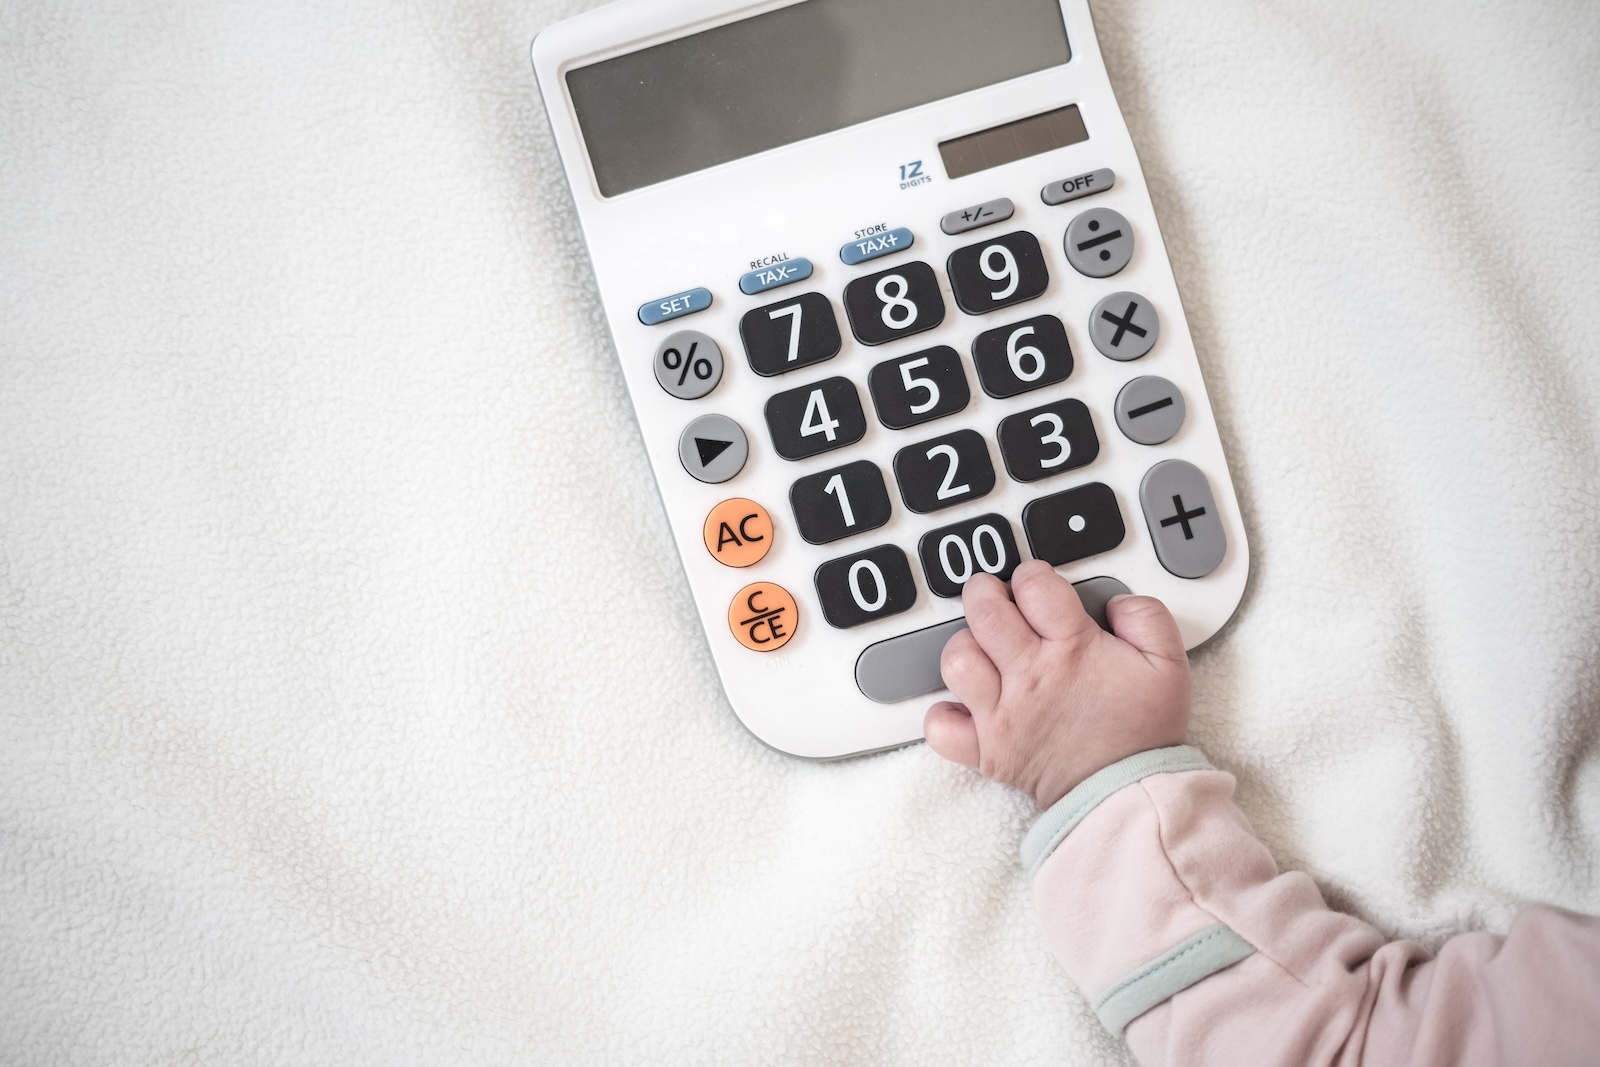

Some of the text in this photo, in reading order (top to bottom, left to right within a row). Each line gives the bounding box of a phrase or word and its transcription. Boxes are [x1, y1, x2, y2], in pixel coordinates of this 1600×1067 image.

[899, 161, 923, 180] 12
[900, 175, 931, 190] DIGITS
[1062, 174, 1094, 193] OFF
[855, 223, 888, 239] STORE
[857, 234, 898, 256] TAX+
[750, 253, 789, 270] RECALL
[979, 245, 1019, 300] 9
[660, 295, 692, 315] SET
[875, 274, 918, 330] 8
[769, 303, 802, 362] 7
[1006, 326, 1046, 381] 6
[662, 342, 713, 386] %
[899, 357, 940, 415] 5
[800, 389, 839, 442] 4
[1030, 412, 1071, 468] 3
[926, 444, 970, 500] 2
[824, 474, 855, 527] 1
[717, 513, 764, 552] AC
[938, 524, 1006, 584] 00
[848, 559, 887, 612] 0
[749, 615, 787, 644] CE
